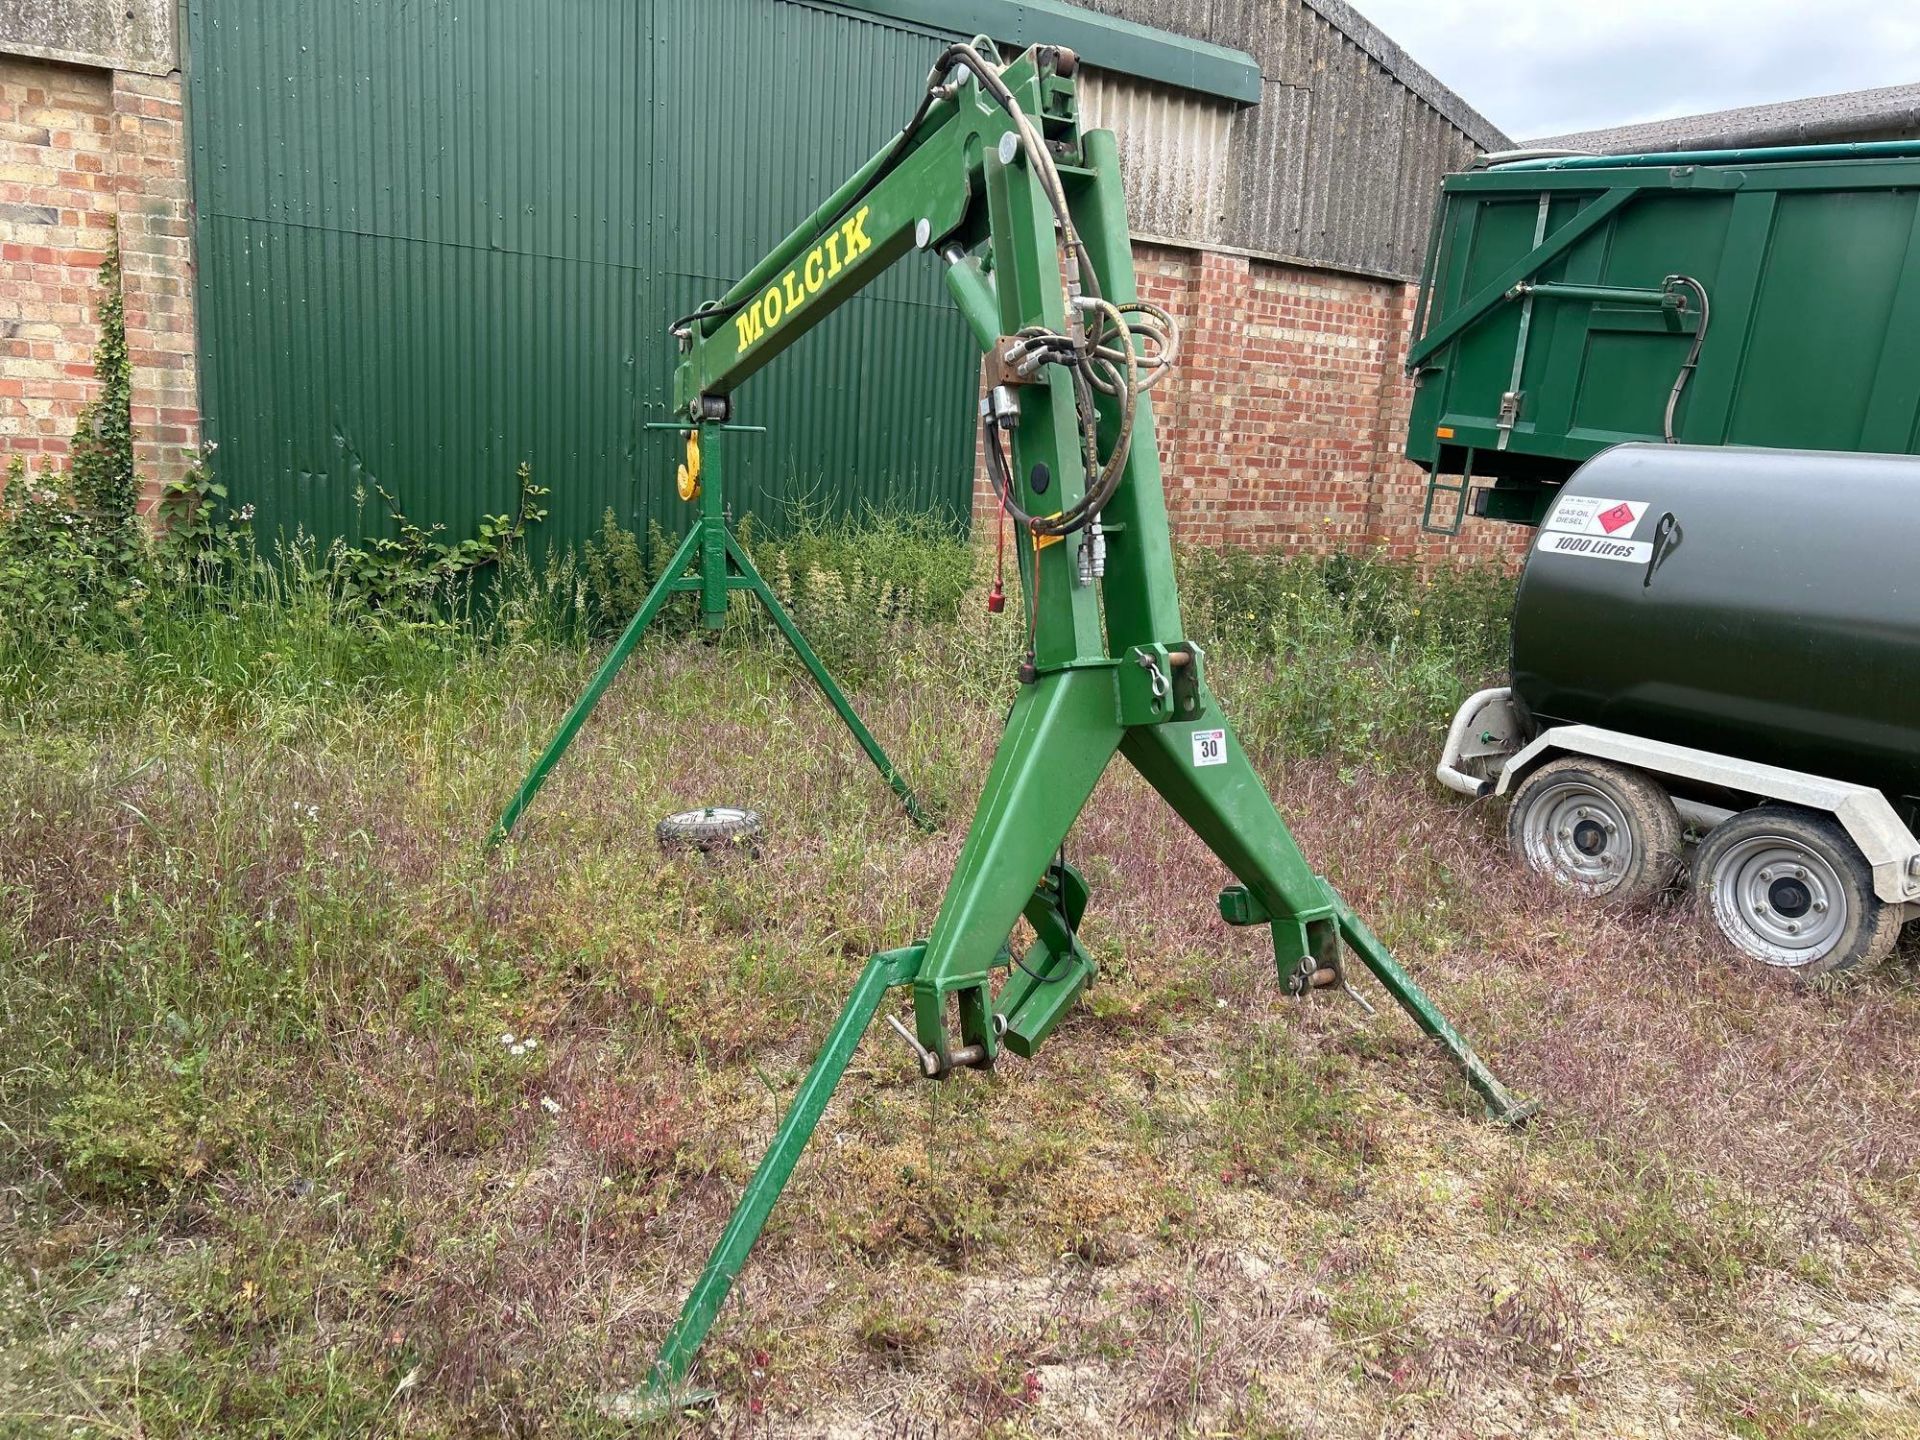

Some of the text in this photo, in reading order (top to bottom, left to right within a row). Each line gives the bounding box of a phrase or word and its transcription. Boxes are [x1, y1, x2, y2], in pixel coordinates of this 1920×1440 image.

[735, 205, 872, 353] MOLCIK
[1555, 516, 1583, 525] DIESEL
[1576, 510, 1589, 518] OIL
[1555, 536, 1635, 557] 1000 Litres
[1201, 740, 1218, 758] 30
